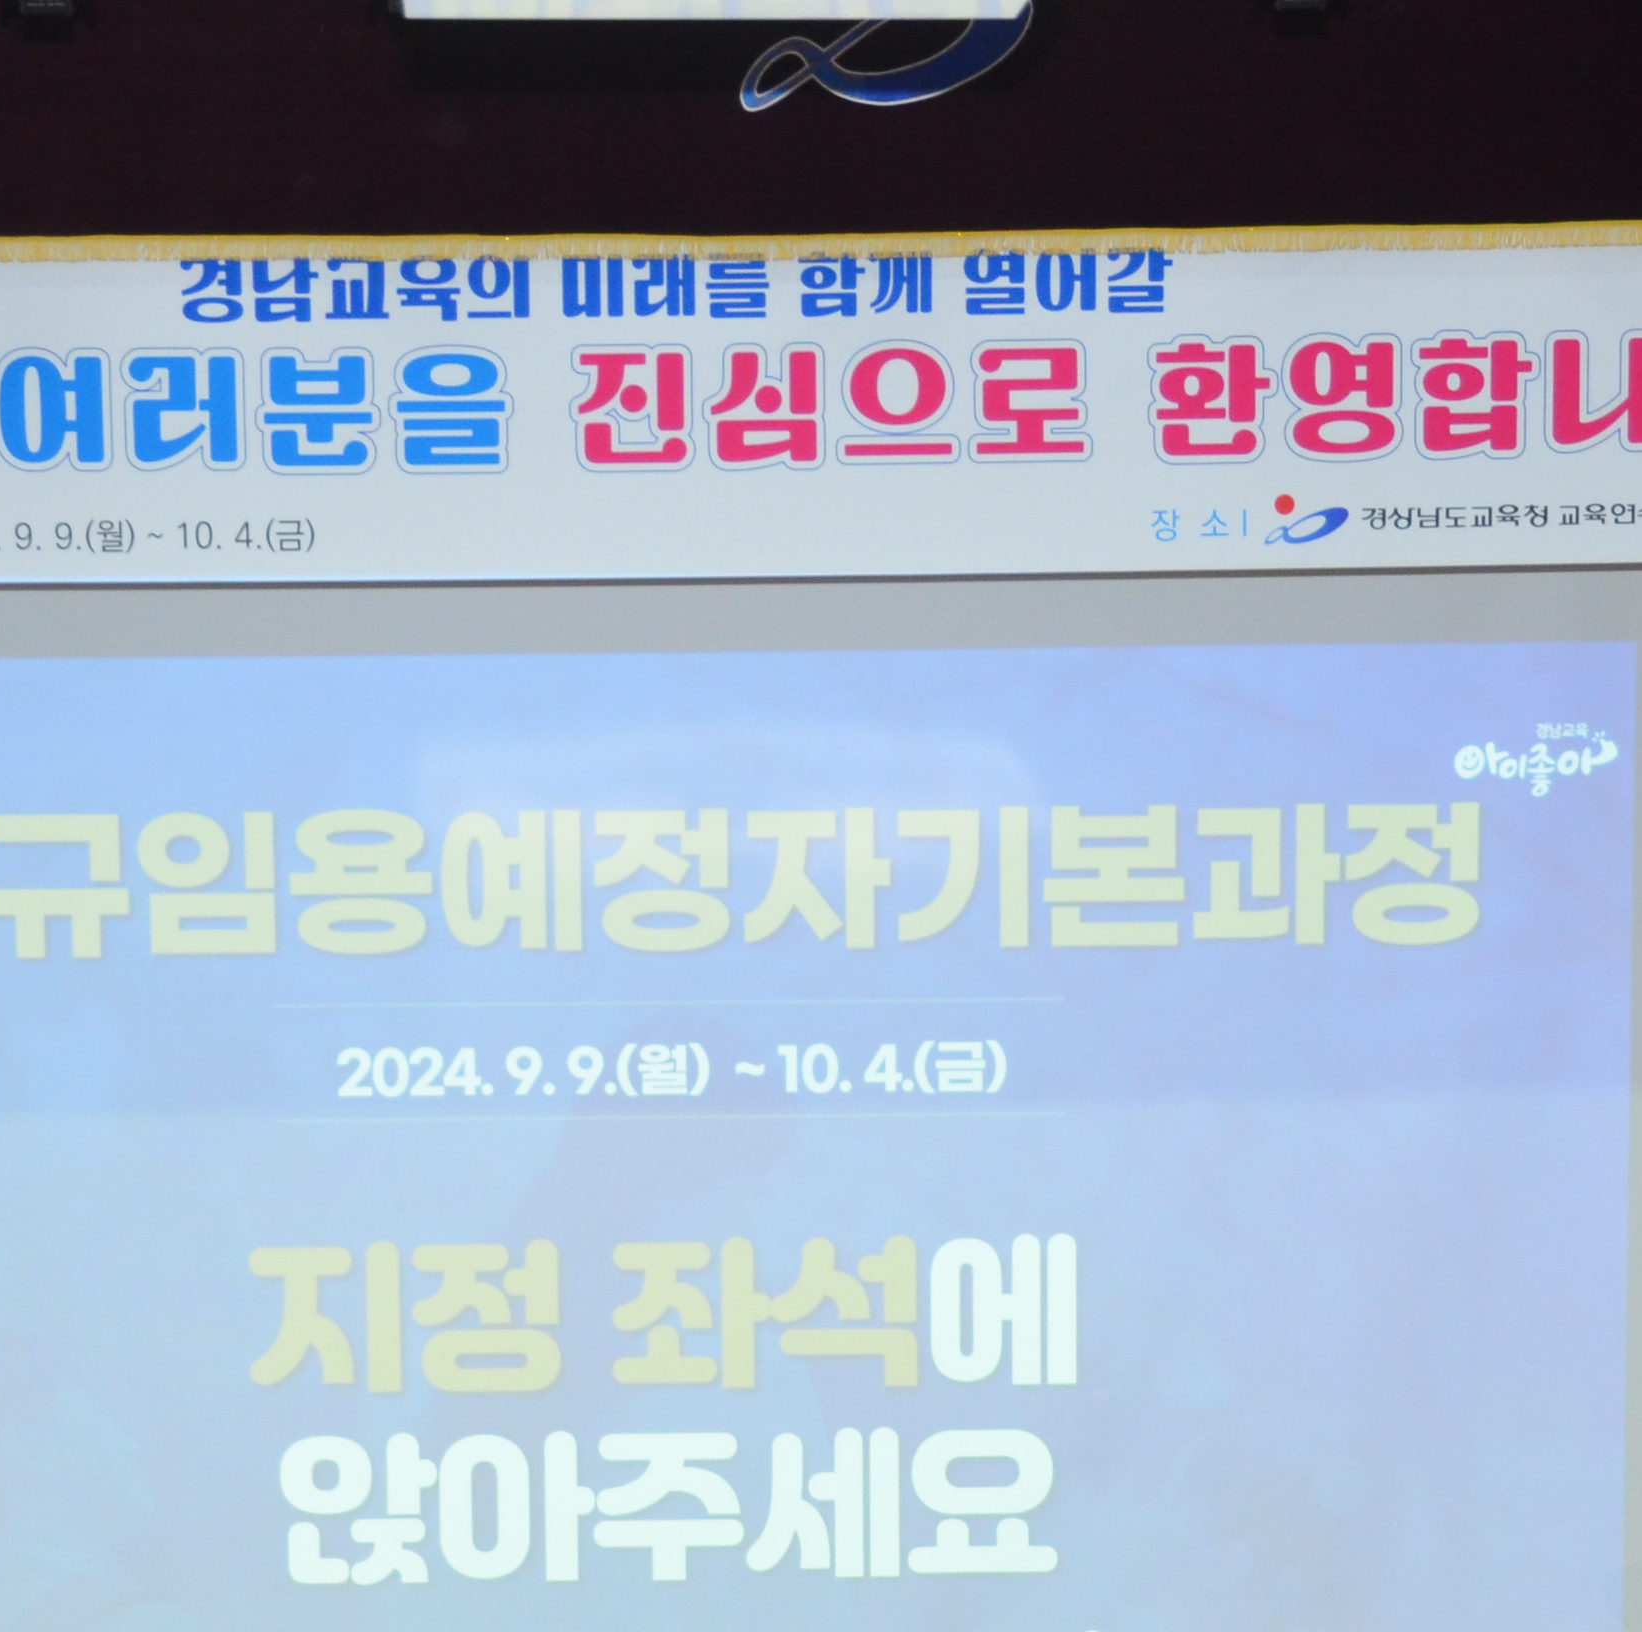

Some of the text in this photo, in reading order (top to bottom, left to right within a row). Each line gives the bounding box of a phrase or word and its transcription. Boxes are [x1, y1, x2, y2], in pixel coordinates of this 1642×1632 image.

[179, 248, 1175, 324] 경남교육의 미래를 함께 열어갈
[575, 347, 1086, 464] 진심으로
[1360, 502, 1550, 530] 경상남도교육청
[1536, 722, 1589, 739] 경남교육
[1454, 741, 1619, 797] 아이좋아
[336, 1045, 495, 1099] 2024.
[246, 1231, 1080, 1397] 지정 좌석에
[277, 1424, 1060, 1588] 앉아주세요
